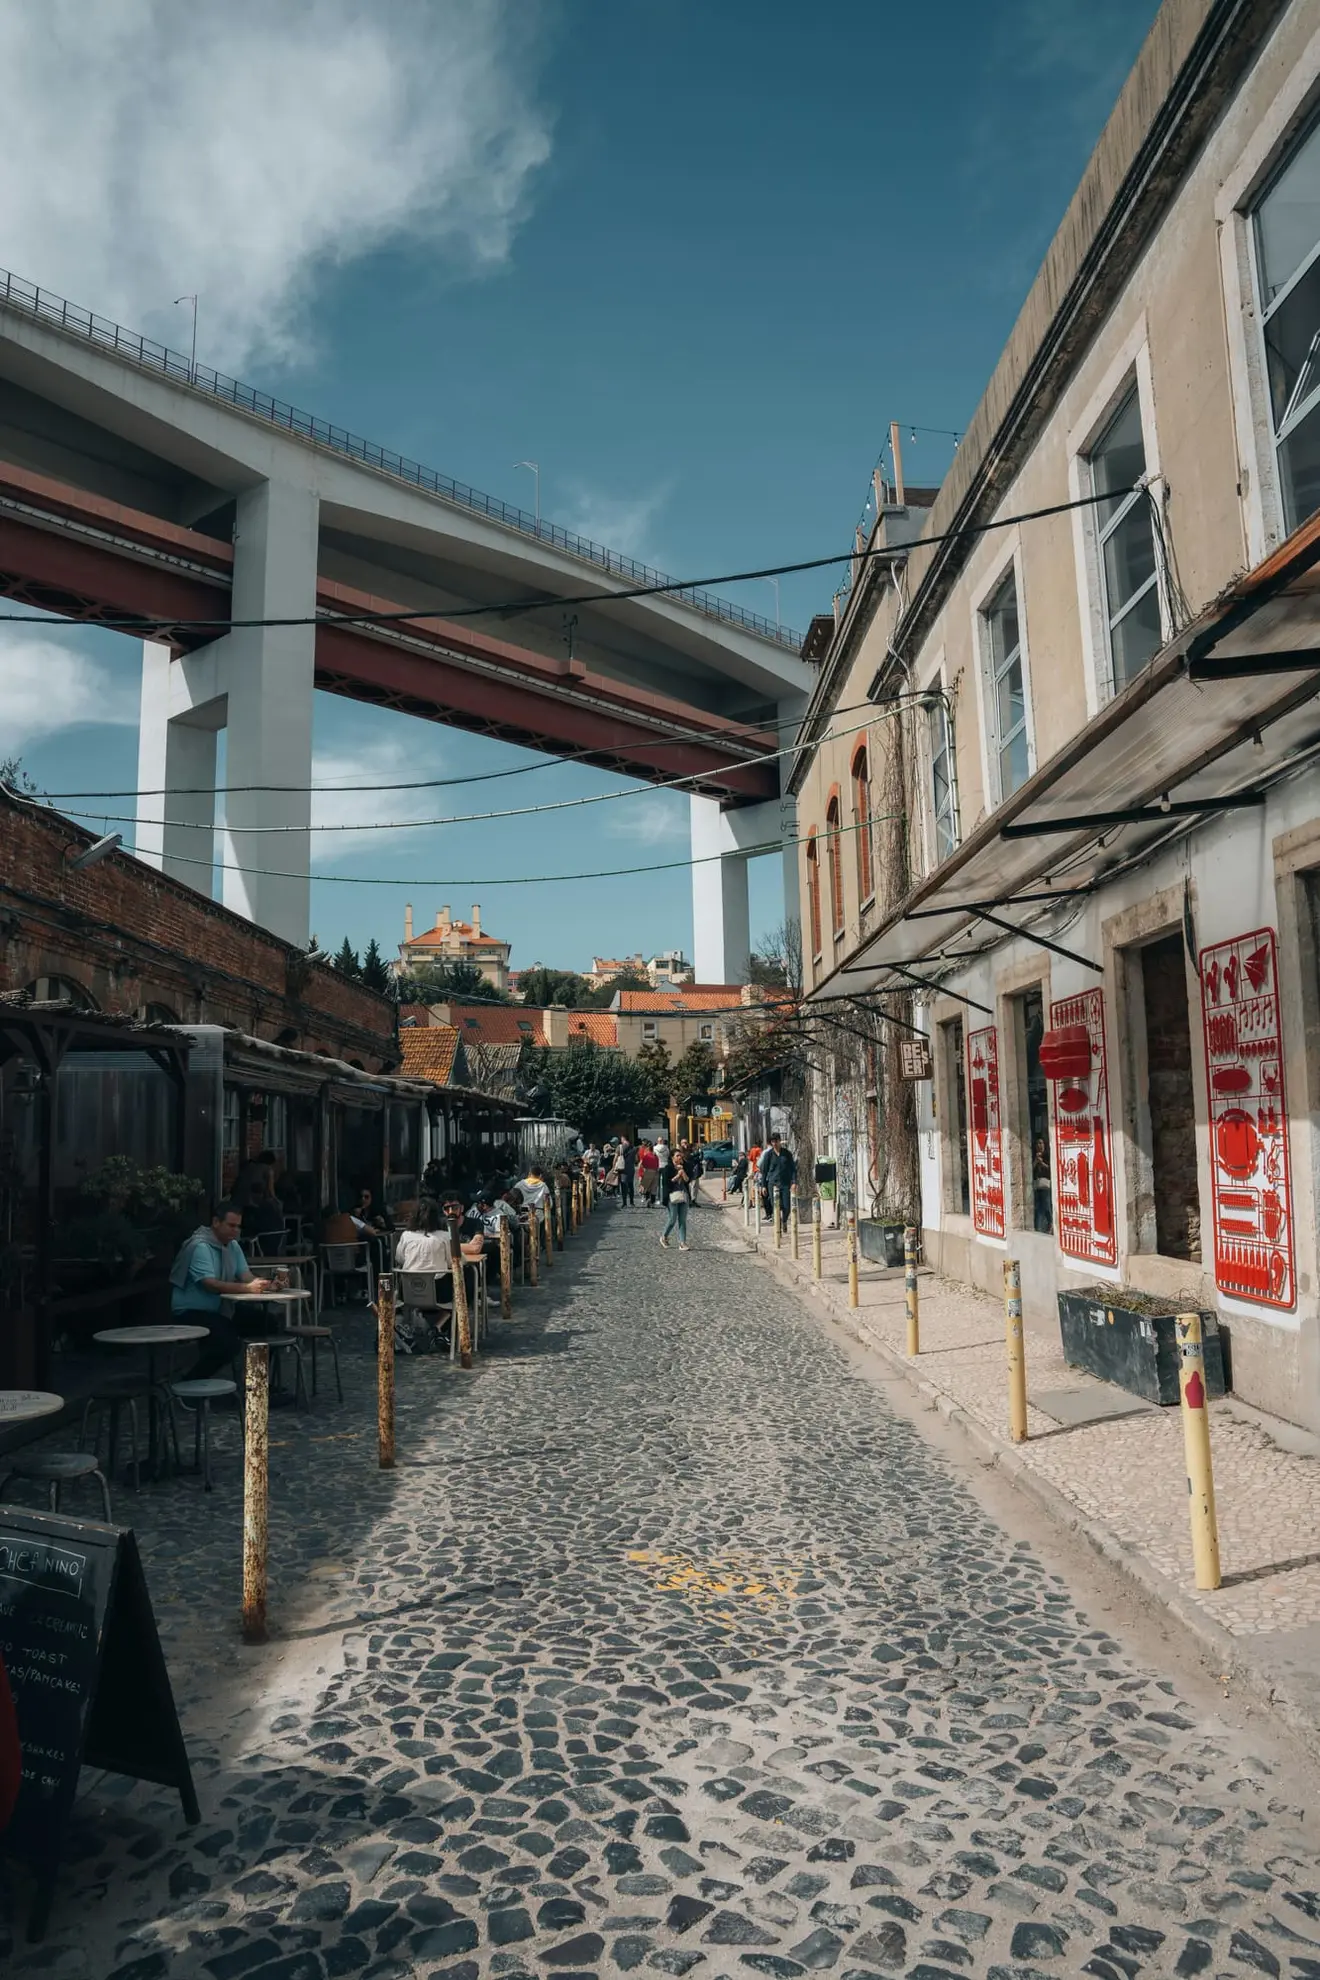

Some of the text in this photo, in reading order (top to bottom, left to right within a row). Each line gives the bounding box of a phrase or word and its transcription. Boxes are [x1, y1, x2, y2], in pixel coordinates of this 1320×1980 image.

[903, 1044, 921, 1059] BE
[905, 1060, 922, 1074] ER
[45, 1557, 80, 1576] NINO
[21, 1648, 68, 1664] TOAST
